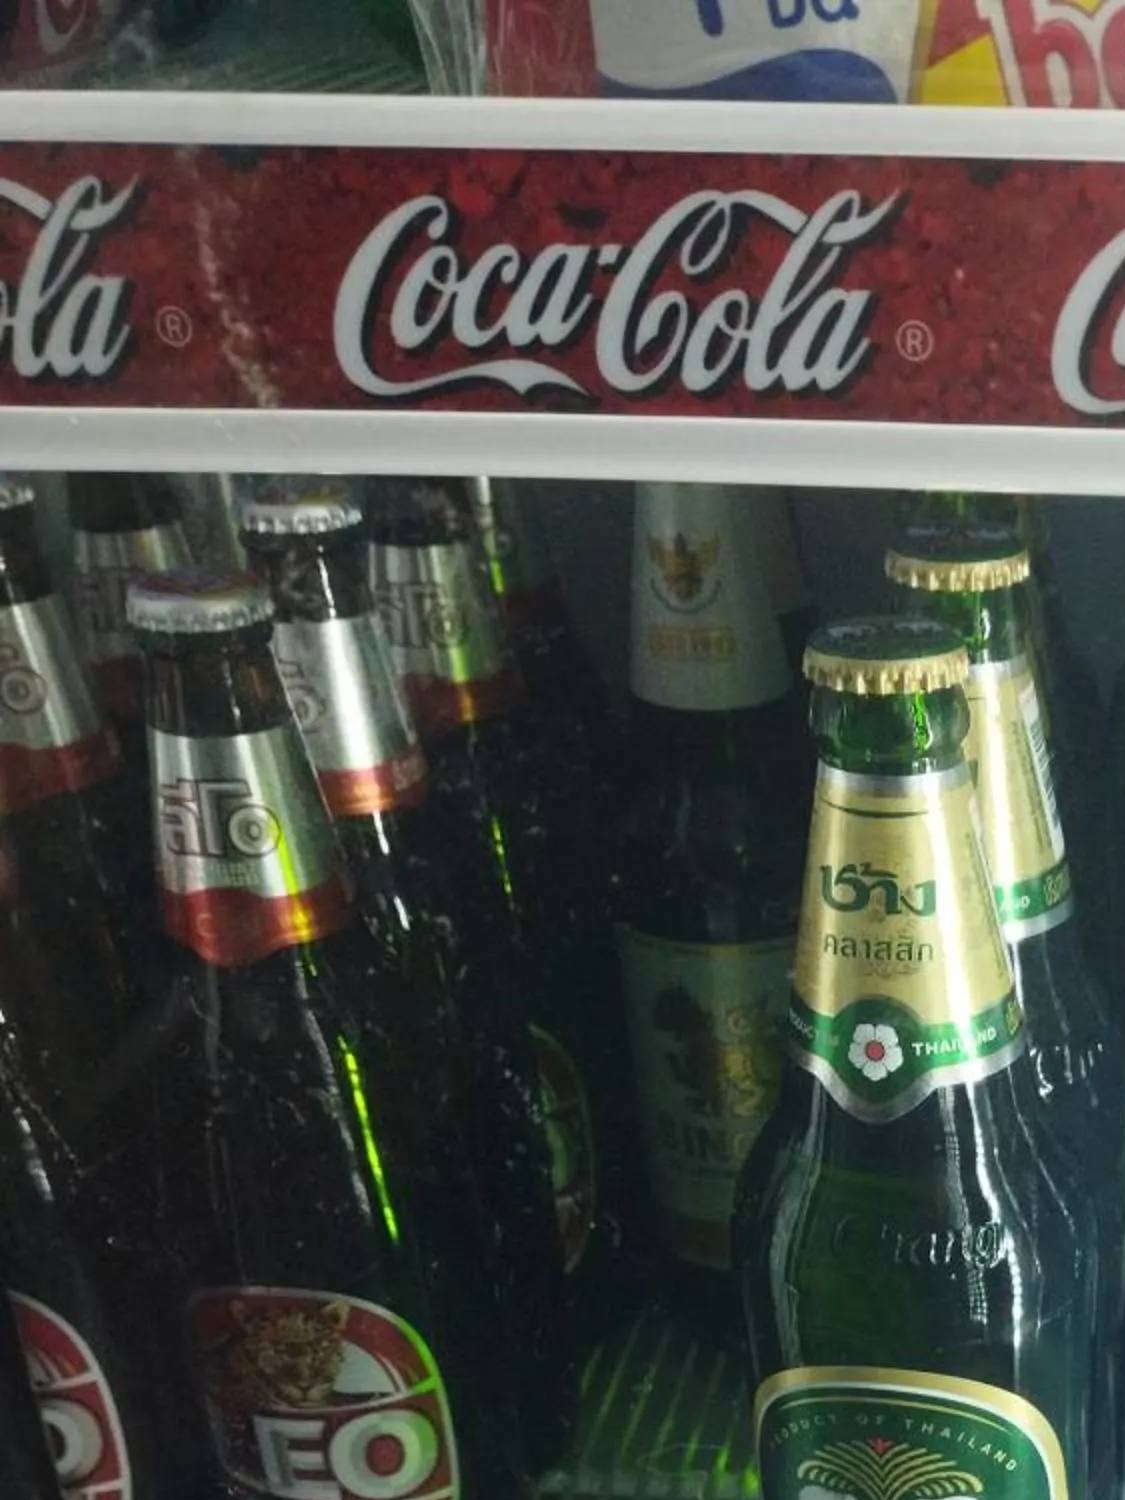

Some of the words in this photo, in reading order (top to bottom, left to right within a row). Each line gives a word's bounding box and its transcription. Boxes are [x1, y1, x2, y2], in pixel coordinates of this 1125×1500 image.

[334, 187, 903, 397] Coca-Cola
[818, 861, 938, 918] ช้าง
[822, 932, 936, 963] คลาสสิก
[910, 1026, 998, 1058] THAIND
[903, 1417, 1018, 1472] THAILAND
